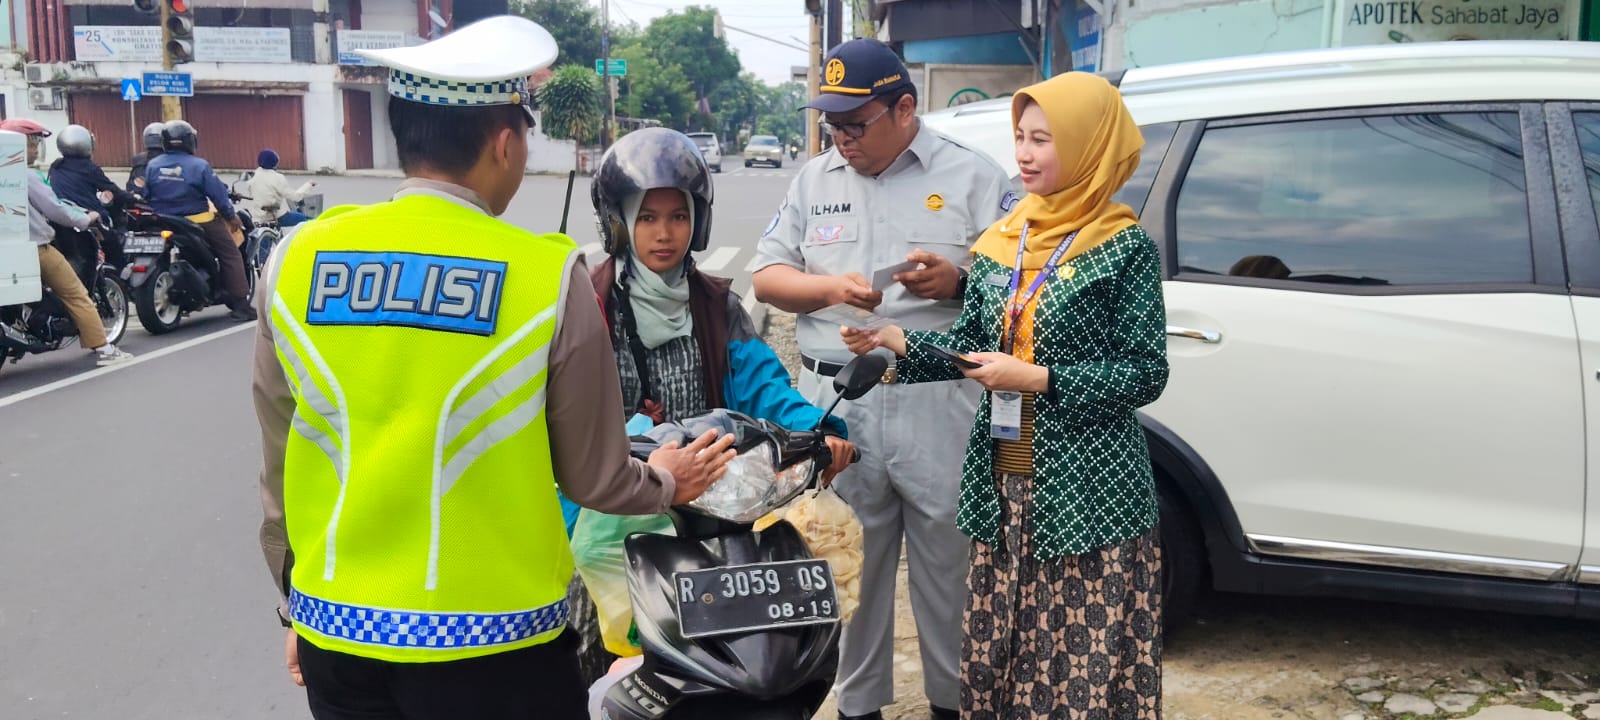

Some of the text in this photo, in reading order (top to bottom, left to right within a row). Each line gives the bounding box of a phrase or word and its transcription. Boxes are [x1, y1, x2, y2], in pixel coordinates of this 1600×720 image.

[1348, 1, 1560, 30] APOTEK Sahabat Jaya
[85, 30, 101, 42] 25
[810, 203, 851, 216] ILHAM
[310, 261, 501, 322] POLISI
[679, 577, 695, 603] R
[720, 569, 781, 598] 3059
[634, 673, 669, 705] HONDA
